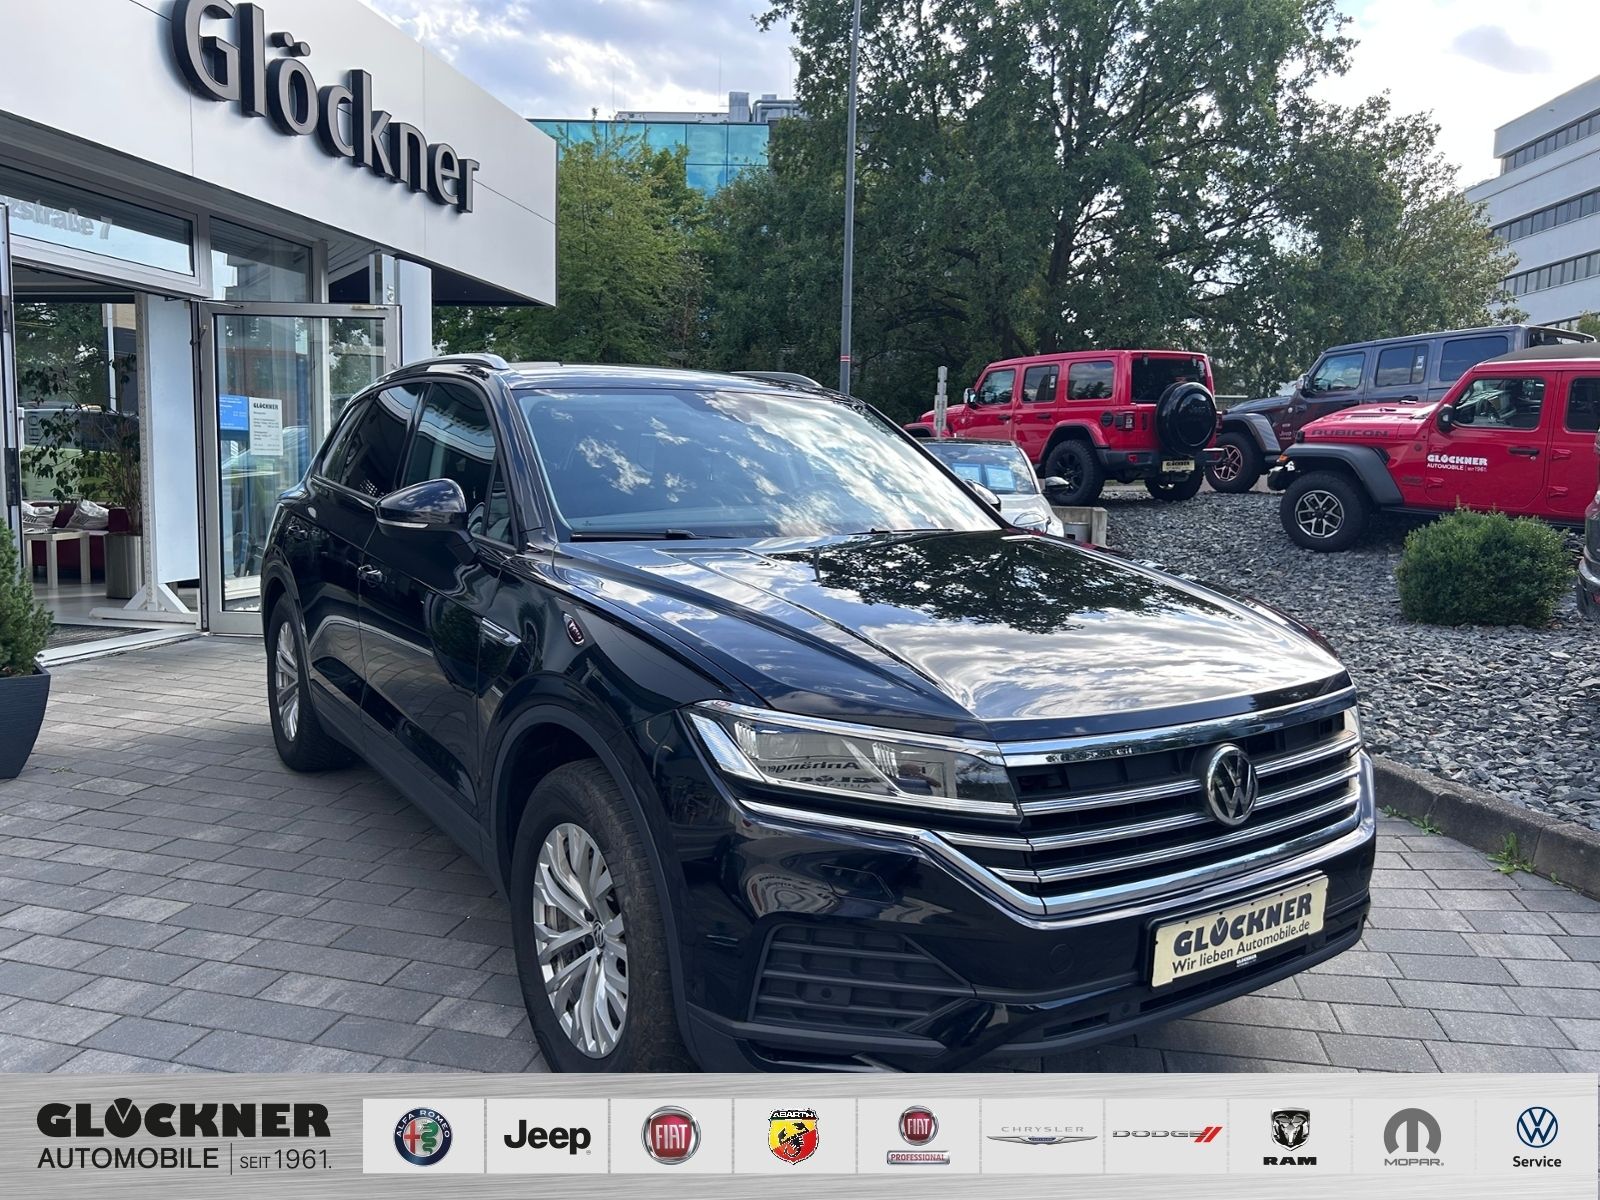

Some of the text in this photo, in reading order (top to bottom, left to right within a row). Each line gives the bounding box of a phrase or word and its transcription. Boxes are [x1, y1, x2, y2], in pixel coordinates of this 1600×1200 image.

[172, 0, 480, 213] Glöckner
[99, 215, 112, 240] 7
[1311, 429, 1389, 437] RUBICON
[1427, 462, 1464, 471] AUTOMOBILE
[1172, 959, 1197, 975] Wir
[1199, 948, 1233, 967] lieben
[1236, 920, 1310, 955] Automobile.de
